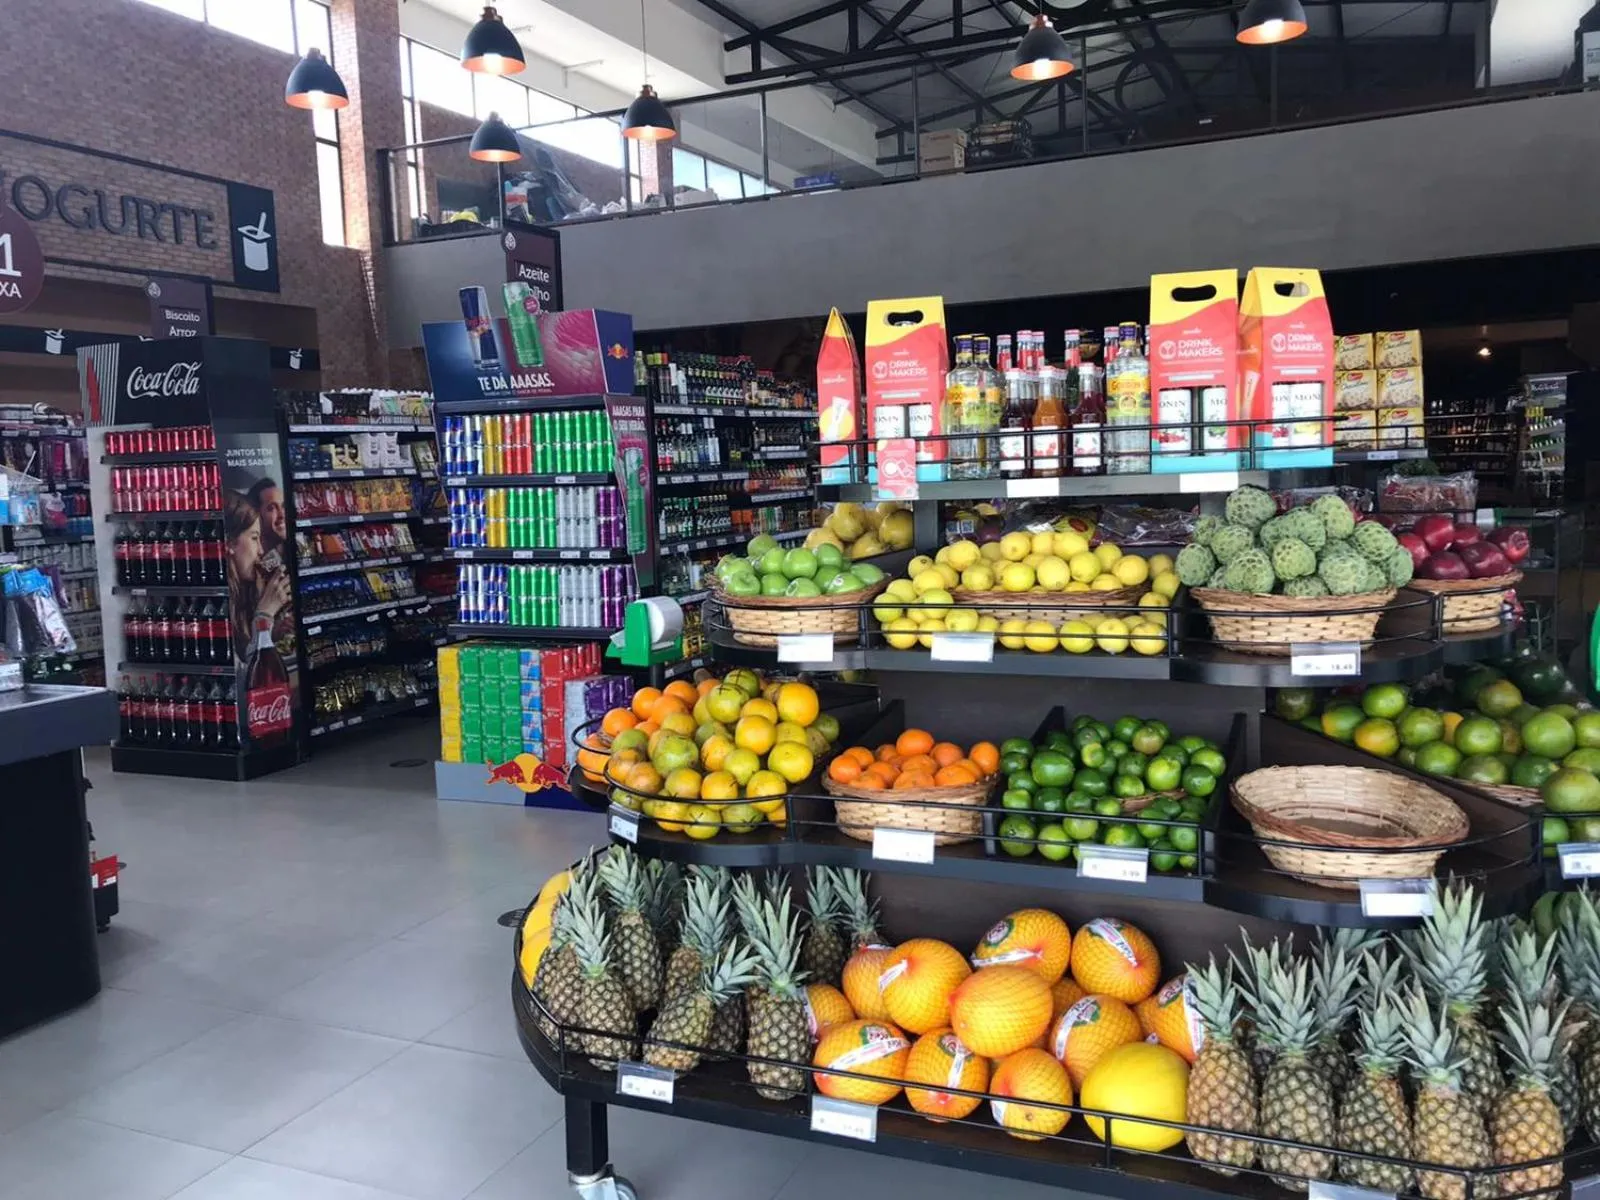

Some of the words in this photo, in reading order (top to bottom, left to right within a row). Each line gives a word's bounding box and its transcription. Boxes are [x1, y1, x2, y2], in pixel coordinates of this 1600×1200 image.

[0, 168, 219, 250] OGURTE
[519, 263, 550, 283] Azeite
[165, 309, 201, 322] Biscoito
[169, 325, 197, 338] Arroz
[1178, 338, 1213, 349] DRINK
[1178, 346, 1224, 358] MAKERS
[889, 360, 920, 369] DRINK
[889, 367, 929, 377] MAKERS
[126, 361, 204, 400] Coca-Cola
[477, 376, 492, 392] TE
[492, 371, 509, 390] DÁ
[227, 458, 247, 468] MAIS
